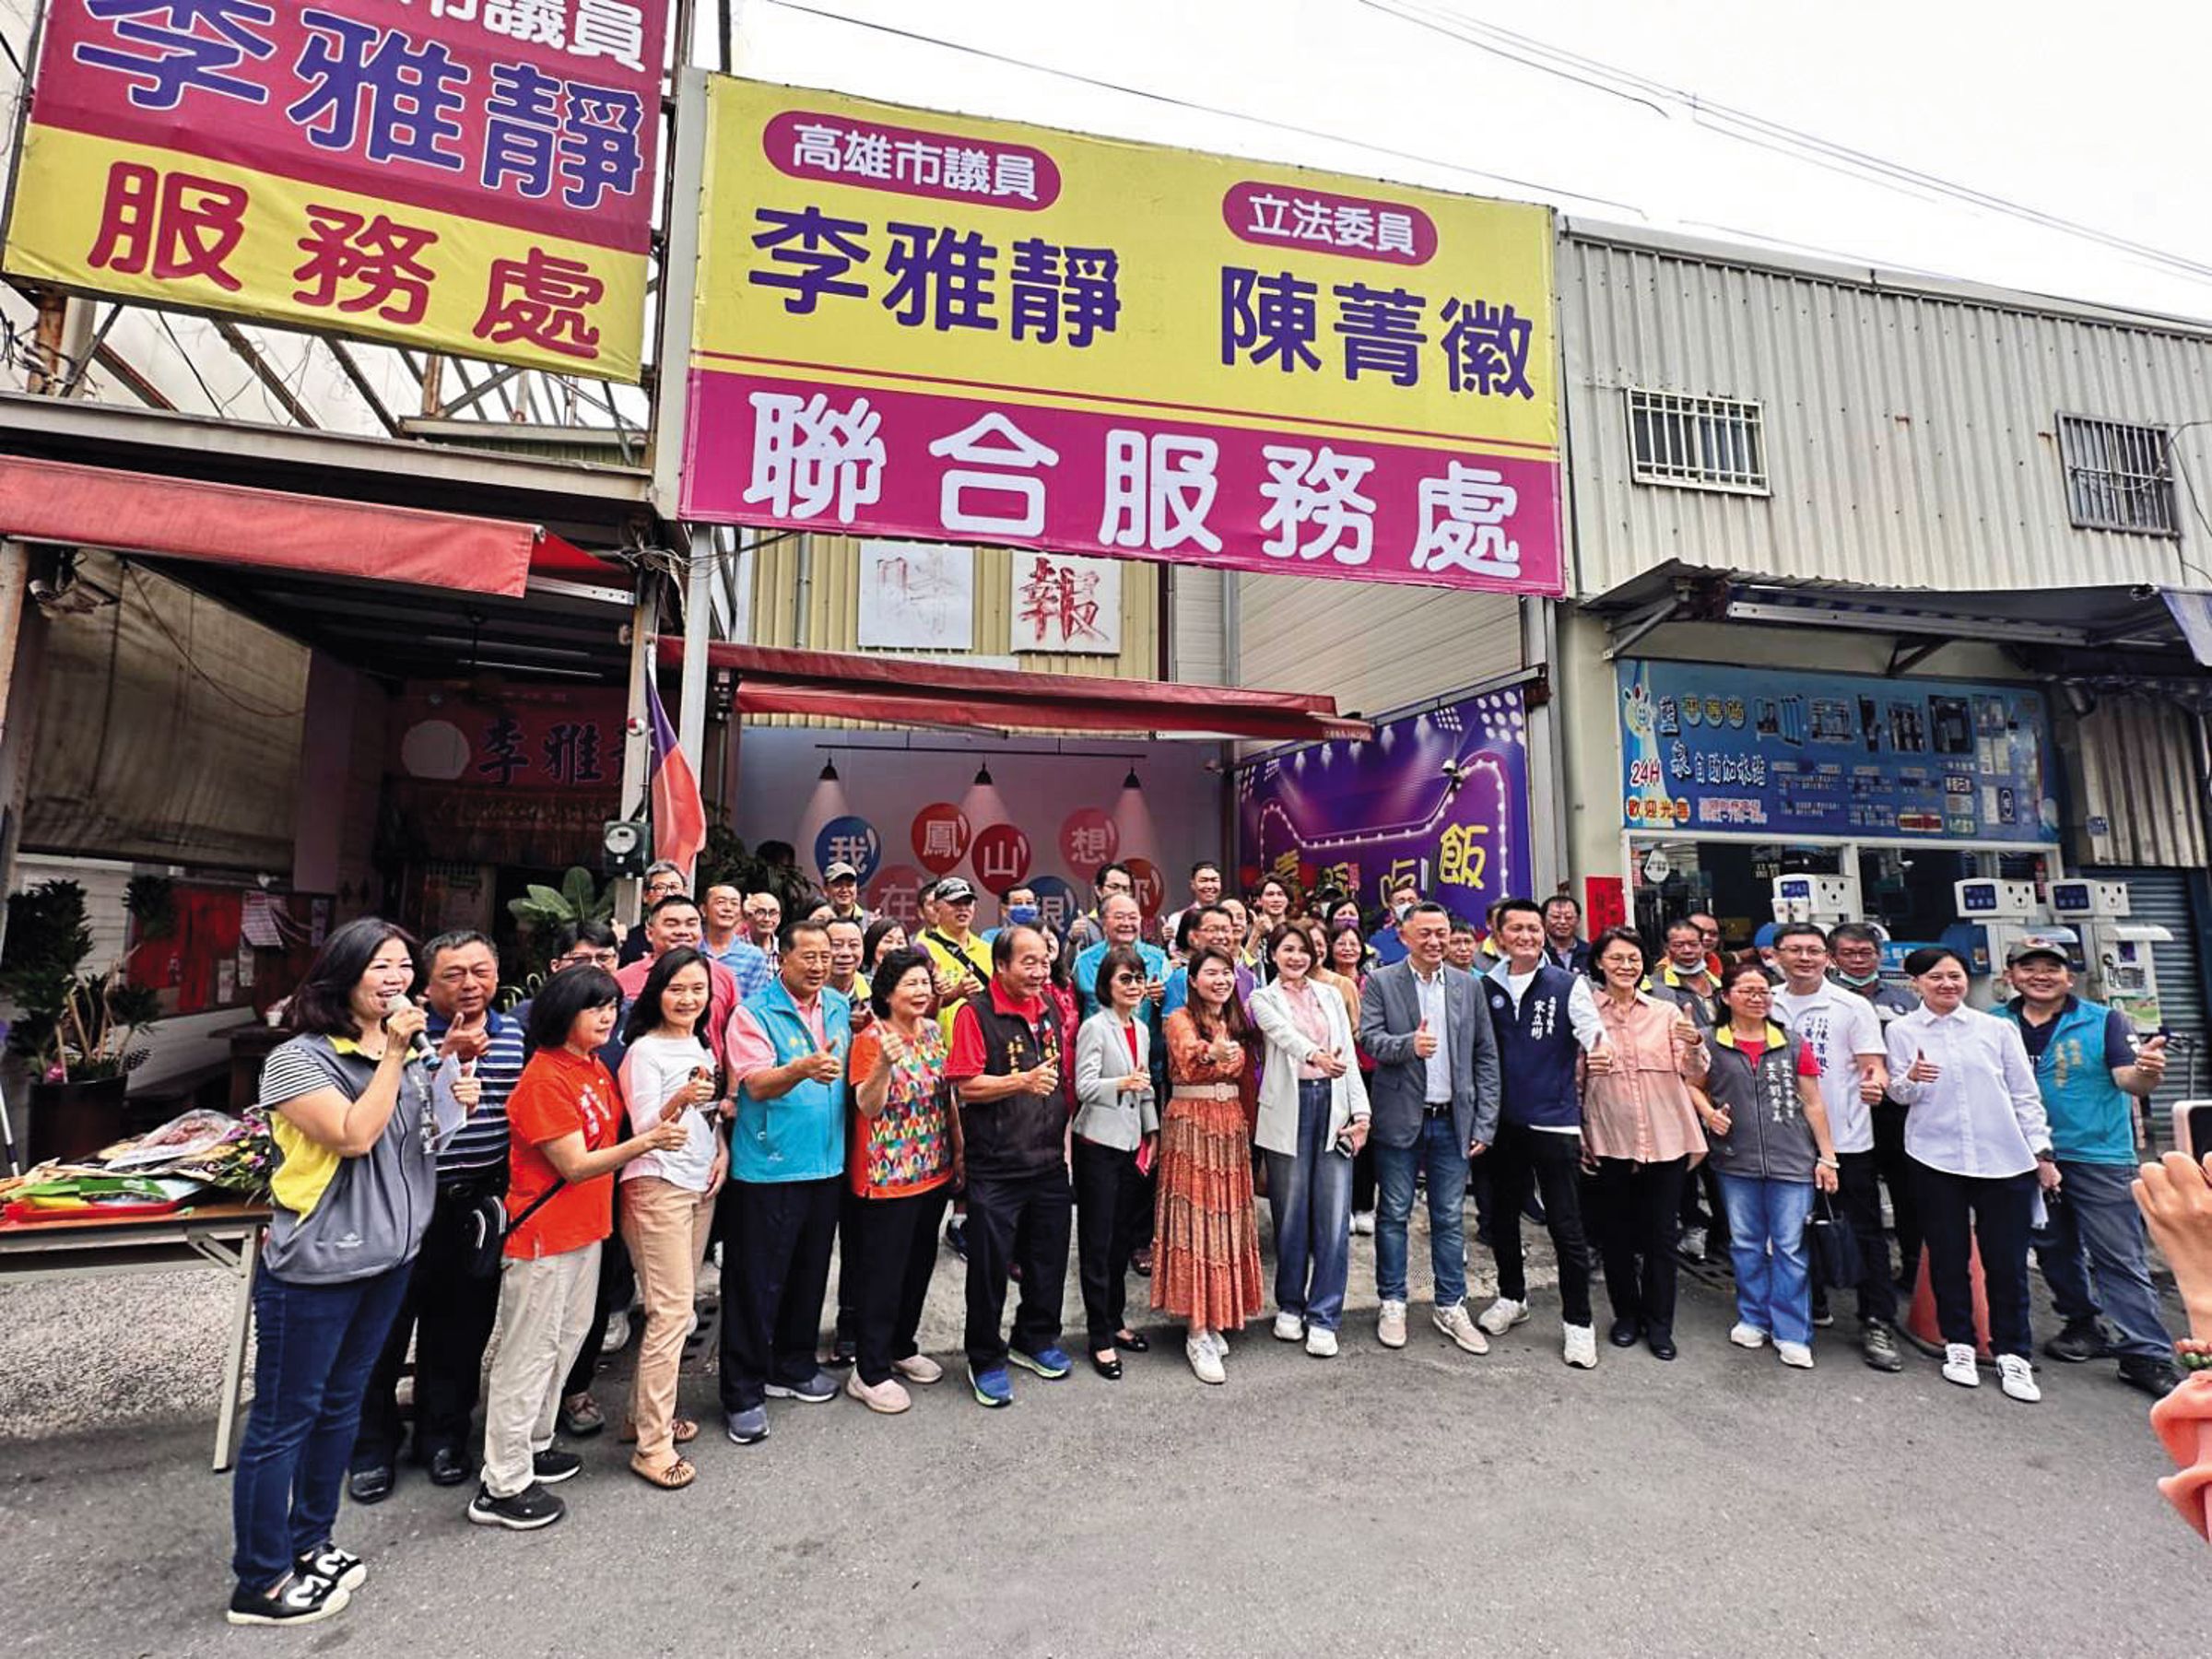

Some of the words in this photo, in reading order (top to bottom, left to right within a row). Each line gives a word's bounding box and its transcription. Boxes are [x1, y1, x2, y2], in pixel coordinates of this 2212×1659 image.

[73, 0, 644, 209] 李雅靜
[793, 123, 1039, 201] 高雄市議員
[88, 160, 605, 359] 服務處
[1248, 194, 1416, 258] 立法委員
[748, 206, 1121, 348] 李雅靜
[1221, 266, 1534, 400] 陳菁徽
[743, 392, 1521, 579] 聯合服務處
[1018, 557, 1109, 642] 報
[478, 715, 627, 788] 李雅
[1630, 759, 1661, 786] 24H
[983, 841, 1018, 878] 山
